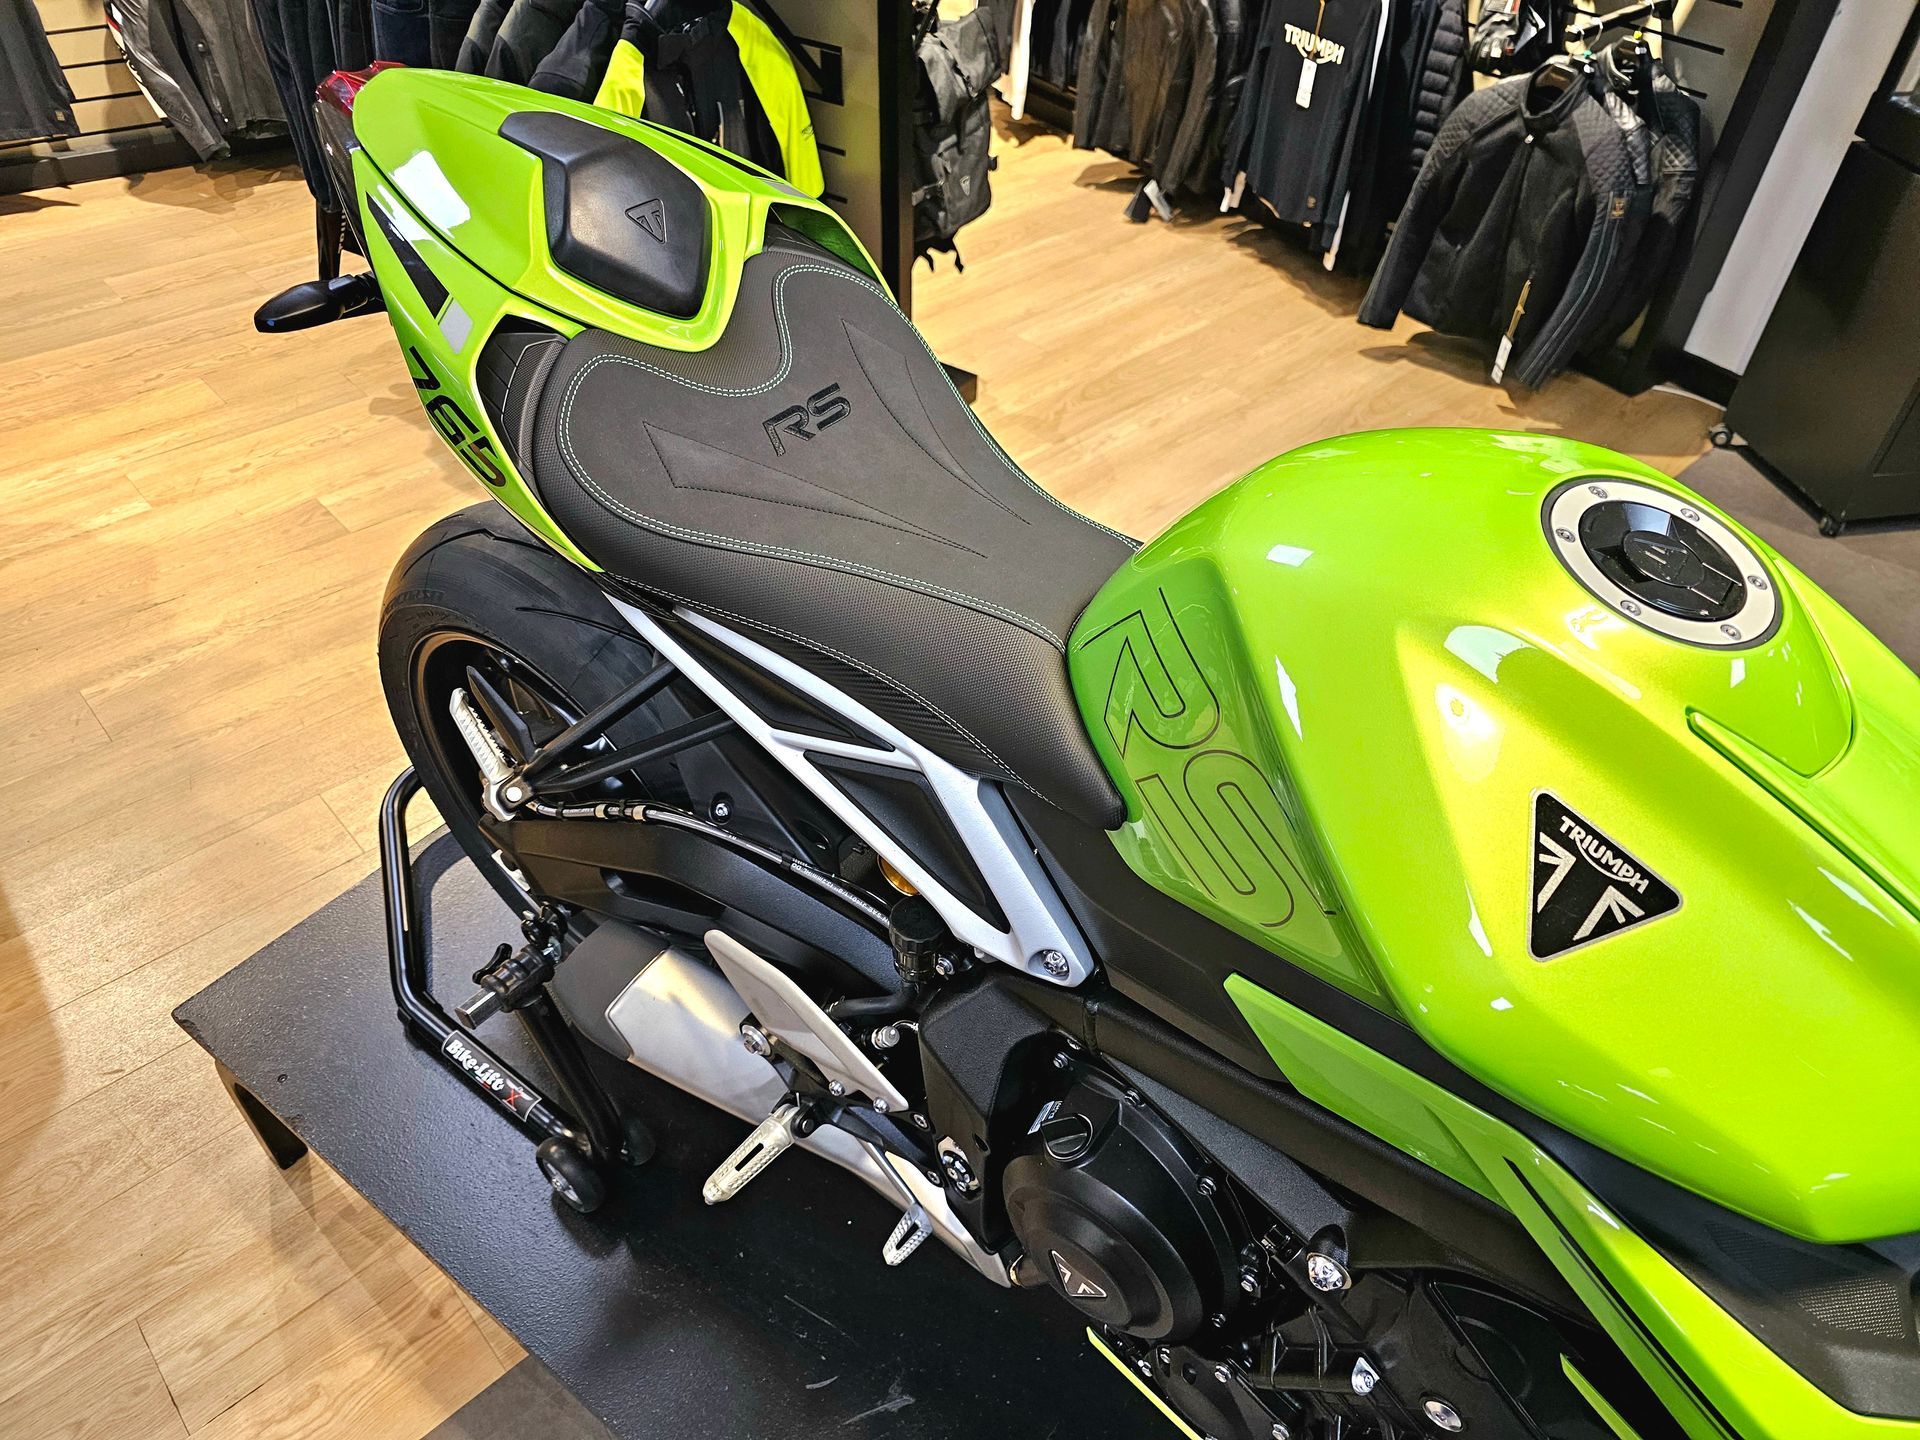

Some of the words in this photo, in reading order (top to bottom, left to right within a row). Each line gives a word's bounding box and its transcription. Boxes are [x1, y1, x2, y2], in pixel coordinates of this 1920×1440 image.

[1284, 23, 1345, 65] TRIUMPH
[408, 345, 507, 488] 765
[762, 382, 852, 457] RS
[1079, 586, 1338, 928] RS
[1559, 815, 1650, 894] TRIUMPH
[446, 1039, 505, 1091] Bike-Lift
